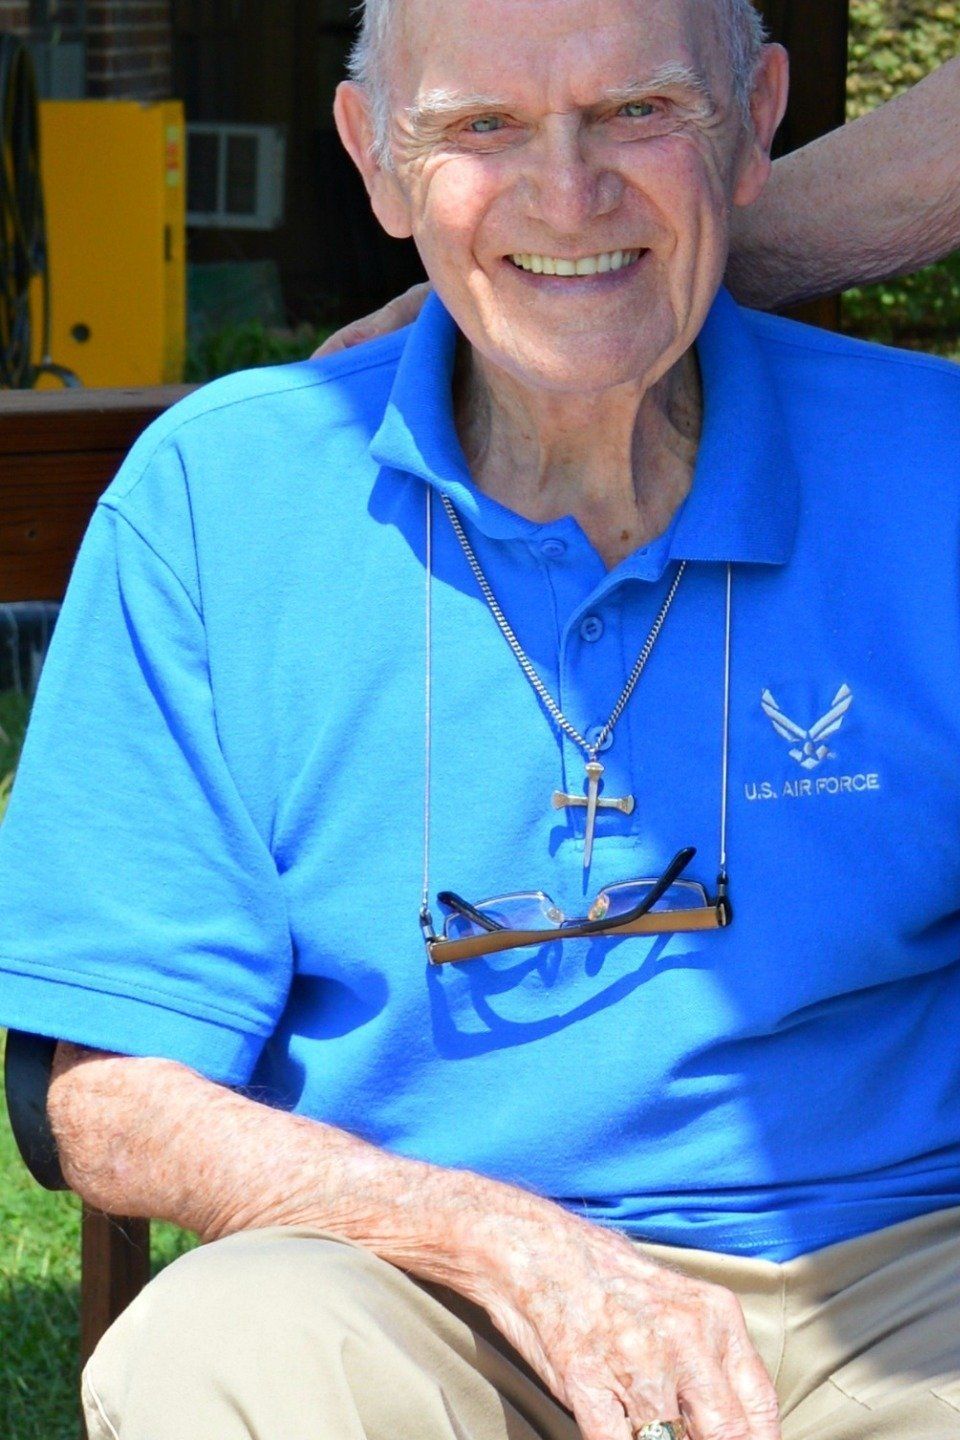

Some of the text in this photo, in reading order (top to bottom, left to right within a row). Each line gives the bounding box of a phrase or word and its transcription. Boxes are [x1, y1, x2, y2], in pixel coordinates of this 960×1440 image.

[744, 773, 880, 800] U.S. AIR FORCE
